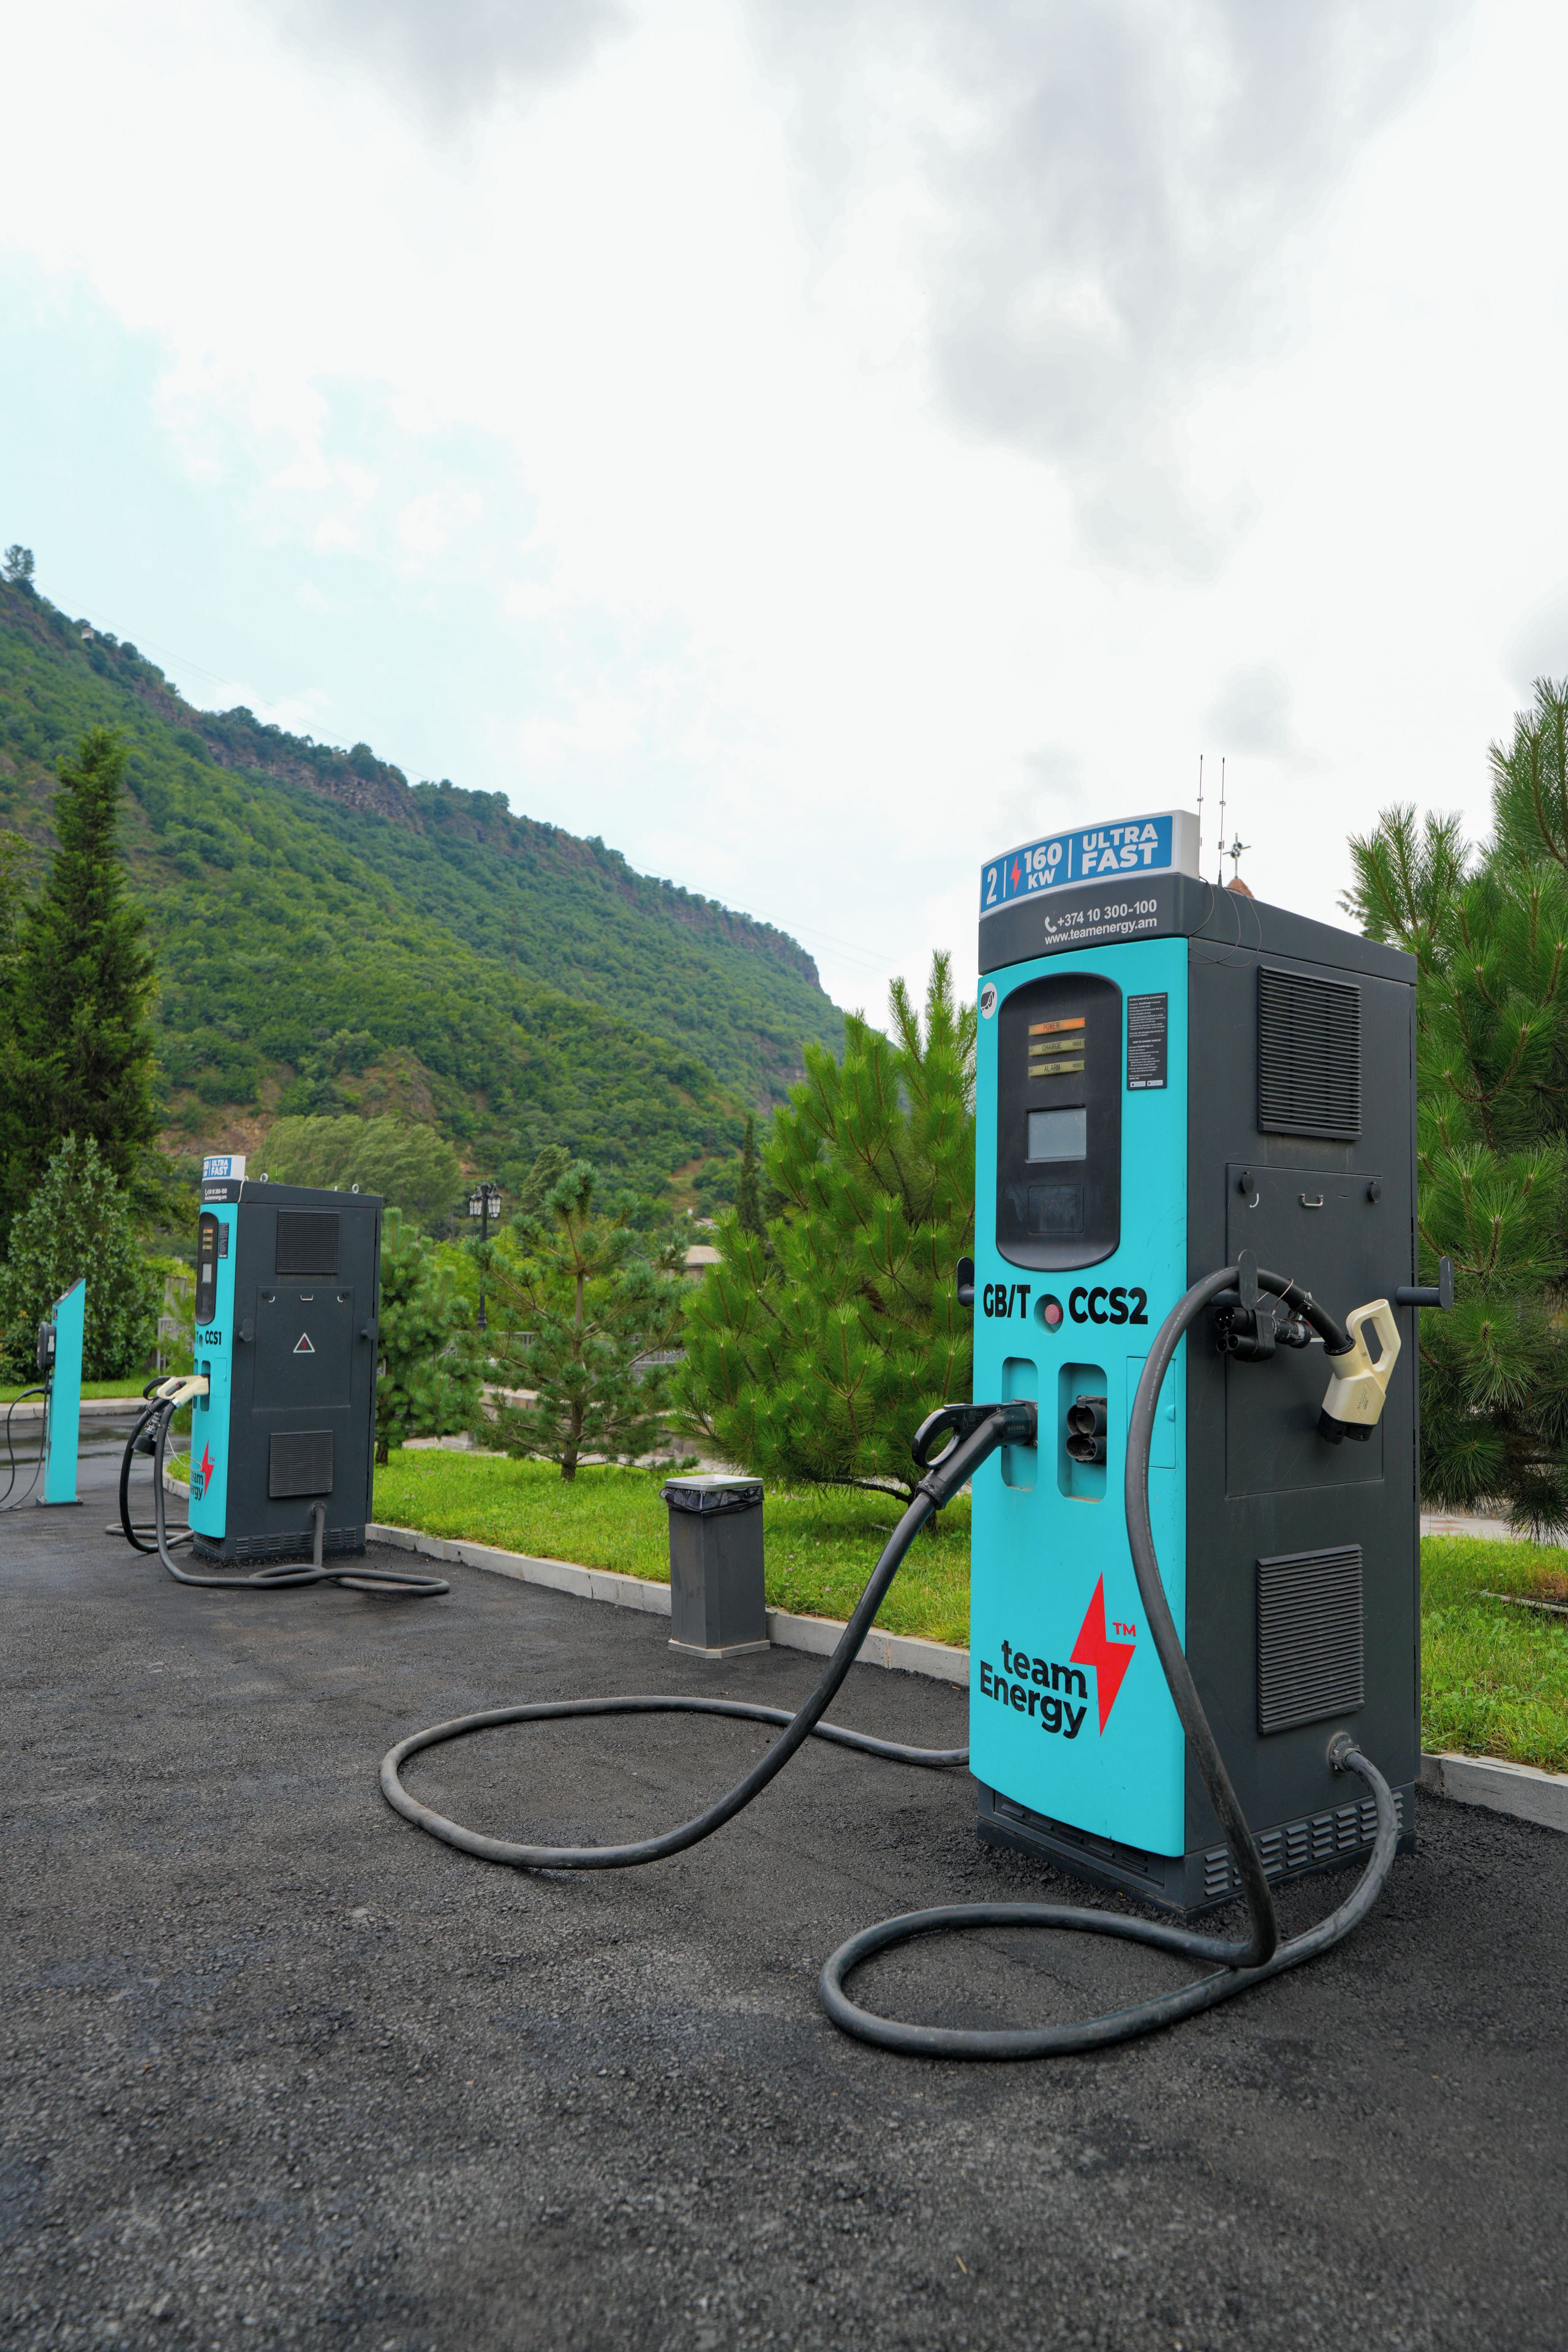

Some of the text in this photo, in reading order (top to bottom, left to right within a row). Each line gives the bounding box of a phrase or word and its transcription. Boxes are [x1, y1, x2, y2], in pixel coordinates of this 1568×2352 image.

[1082, 823, 1158, 851] ULTRA
[1024, 842, 1063, 873] 160
[1082, 841, 1158, 875] FAST
[986, 867, 997, 905] 2
[1028, 867, 1056, 889] KW
[1057, 899, 1157, 929] +374 10 300-100
[1044, 918, 1157, 944] www.teamenergy.am
[1043, 1022, 1060, 1030] POWER
[1042, 1042, 1061, 1051] CHARGE
[1044, 1064, 1061, 1072] ALARM
[211, 1166, 228, 1175] FAST
[983, 1283, 1031, 1319] GB/T
[1068, 1286, 1148, 1325] CCS2
[205, 1330, 221, 1345] CCS1
[1112, 1621, 1136, 1637] TM
[1001, 1640, 1088, 1699] team
[980, 1659, 1088, 1740] Energy
